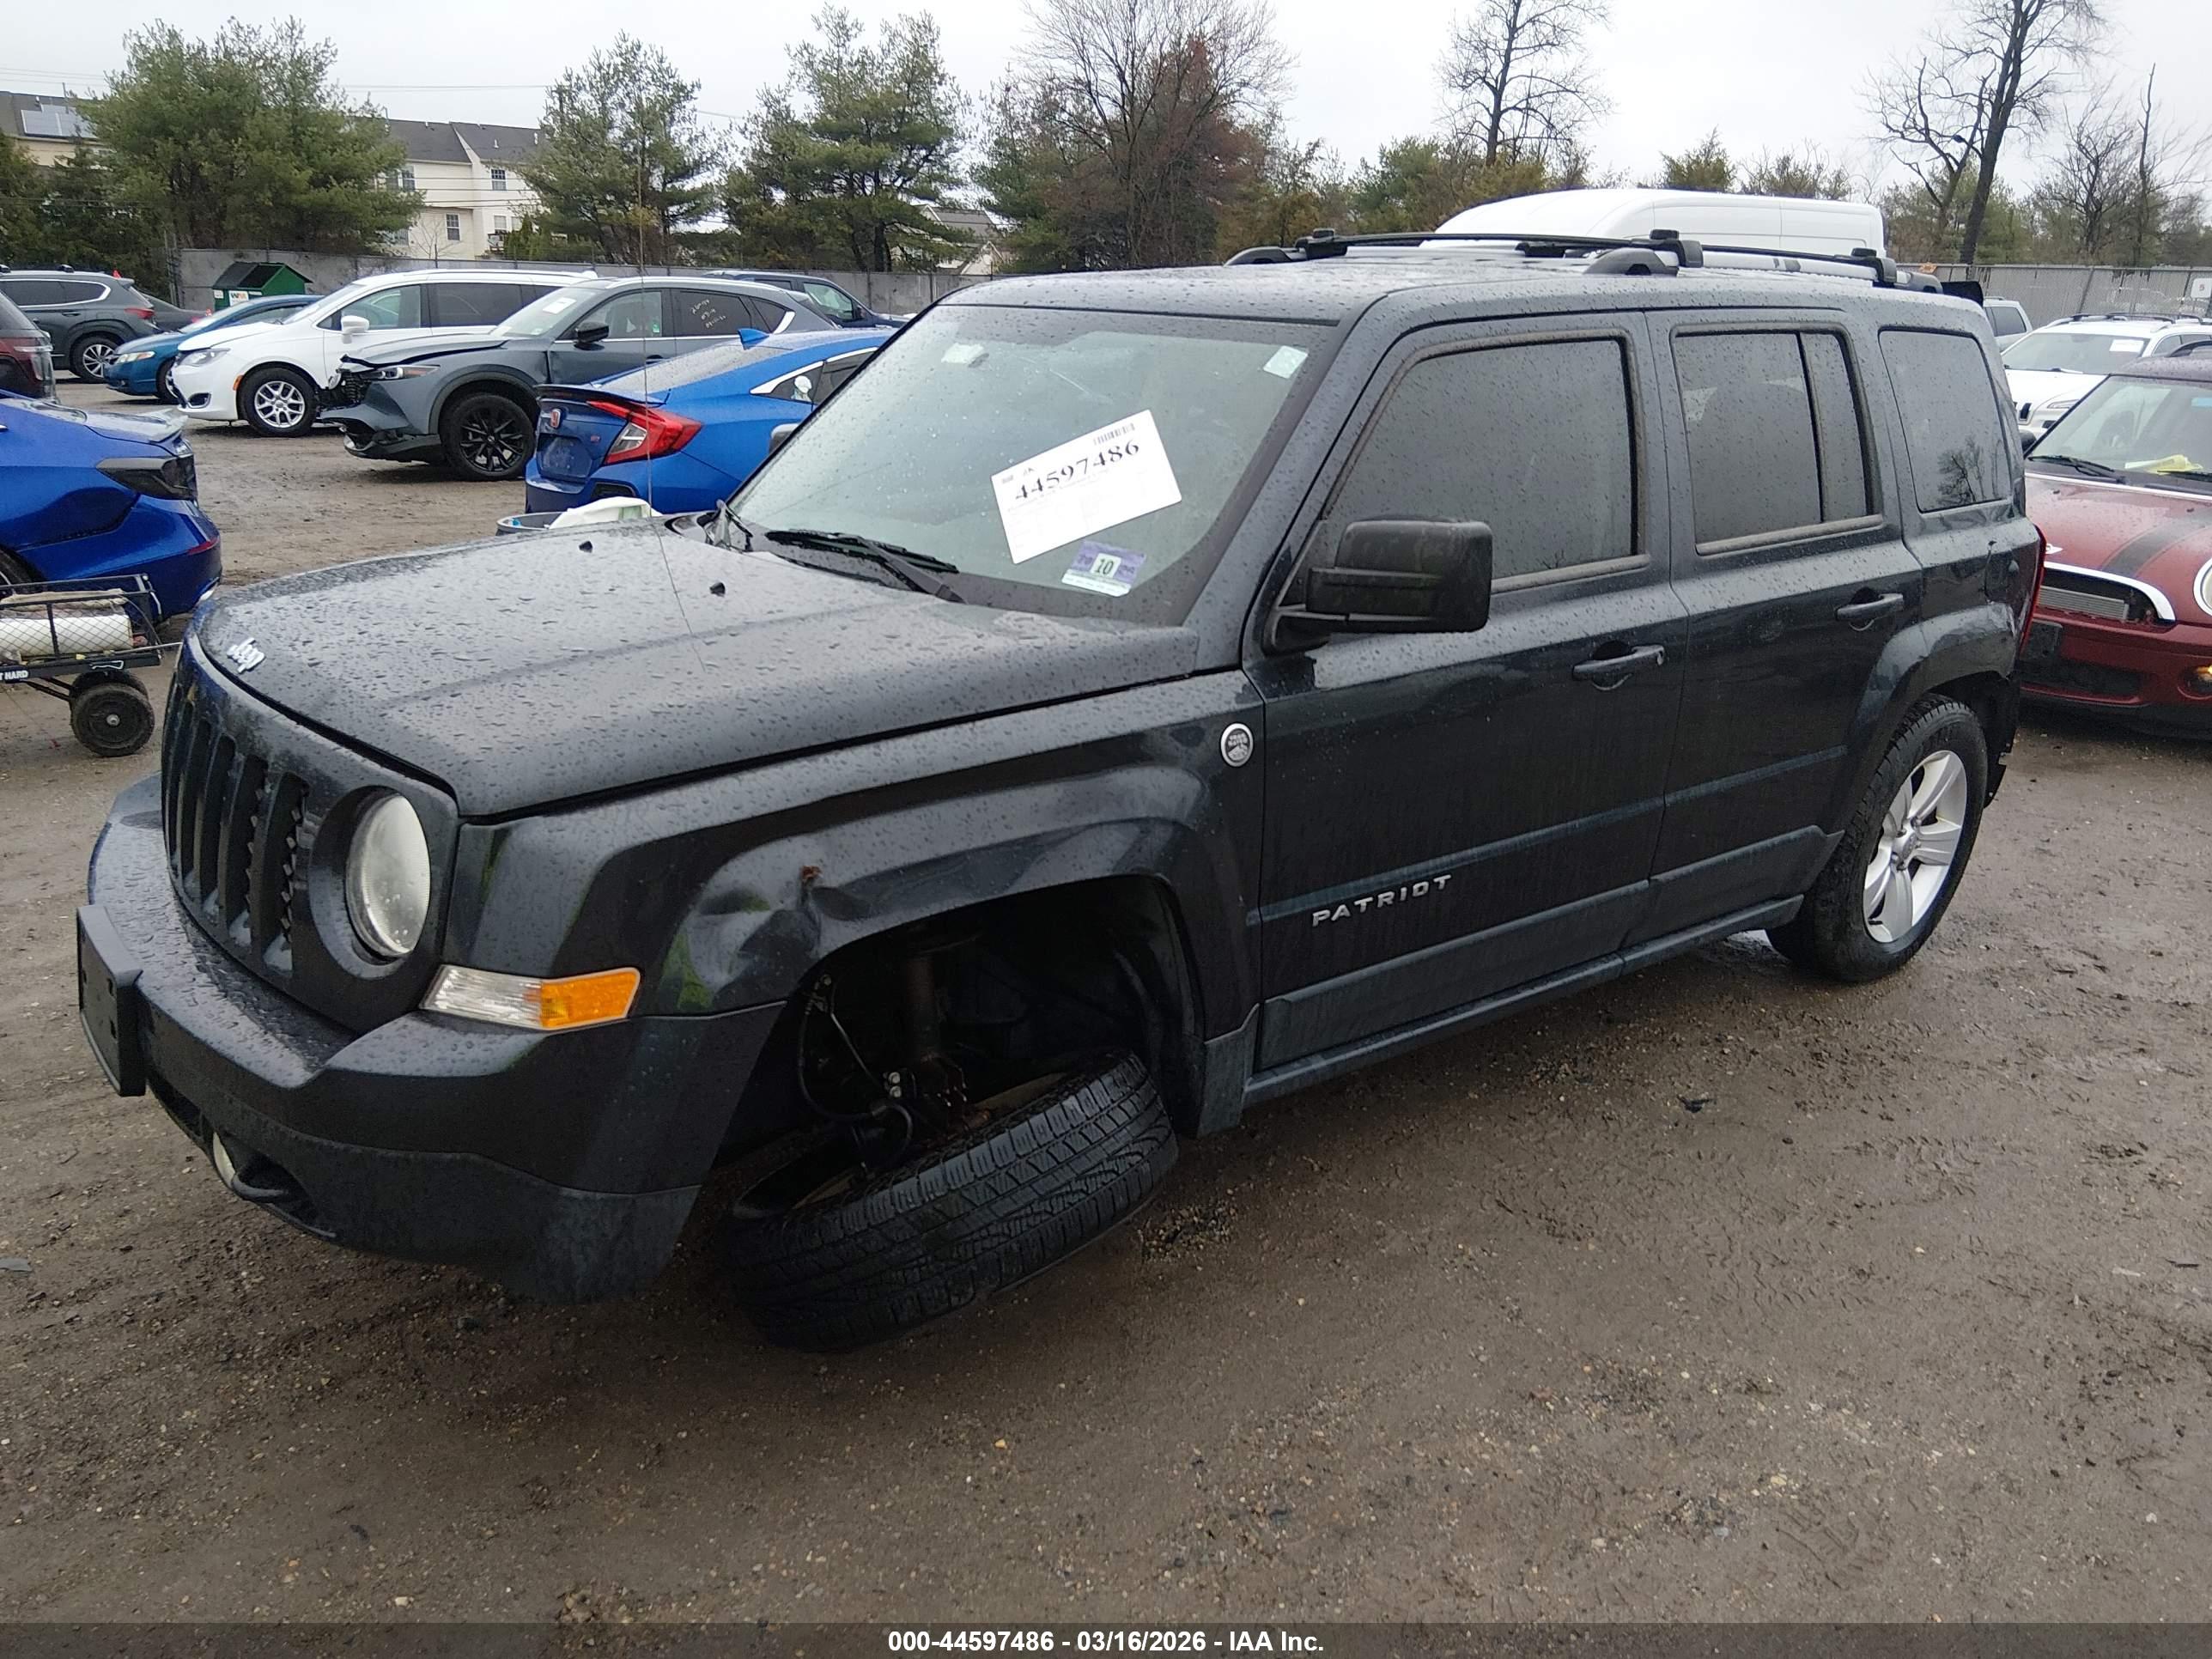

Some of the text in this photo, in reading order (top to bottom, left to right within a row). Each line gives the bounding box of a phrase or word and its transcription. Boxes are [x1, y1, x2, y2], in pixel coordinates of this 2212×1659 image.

[1015, 439, 1139, 500] 44597486
[1095, 558, 1114, 575] 10
[4, 670, 28, 680] HARD
[1312, 874, 1452, 927] PATRIOT
